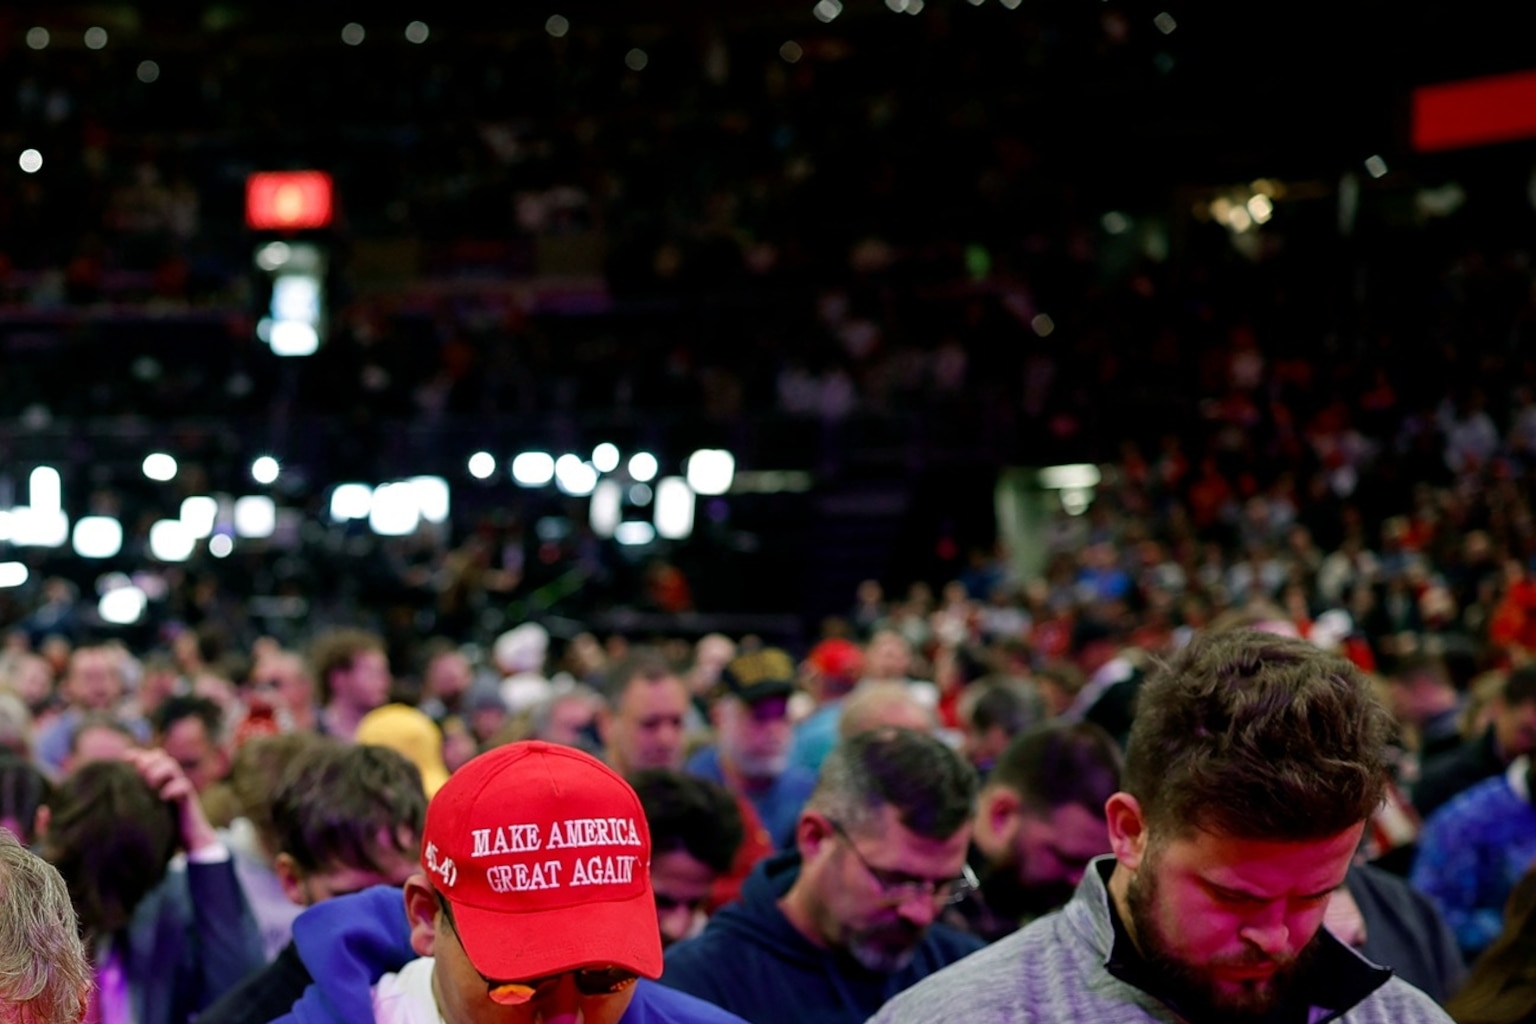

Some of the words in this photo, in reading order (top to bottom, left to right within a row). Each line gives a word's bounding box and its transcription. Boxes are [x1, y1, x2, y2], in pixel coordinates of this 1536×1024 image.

[471, 824, 542, 858] MAKE
[546, 818, 641, 849] AMERICA
[487, 860, 562, 893] GREAT
[570, 855, 634, 887] AGAIN
